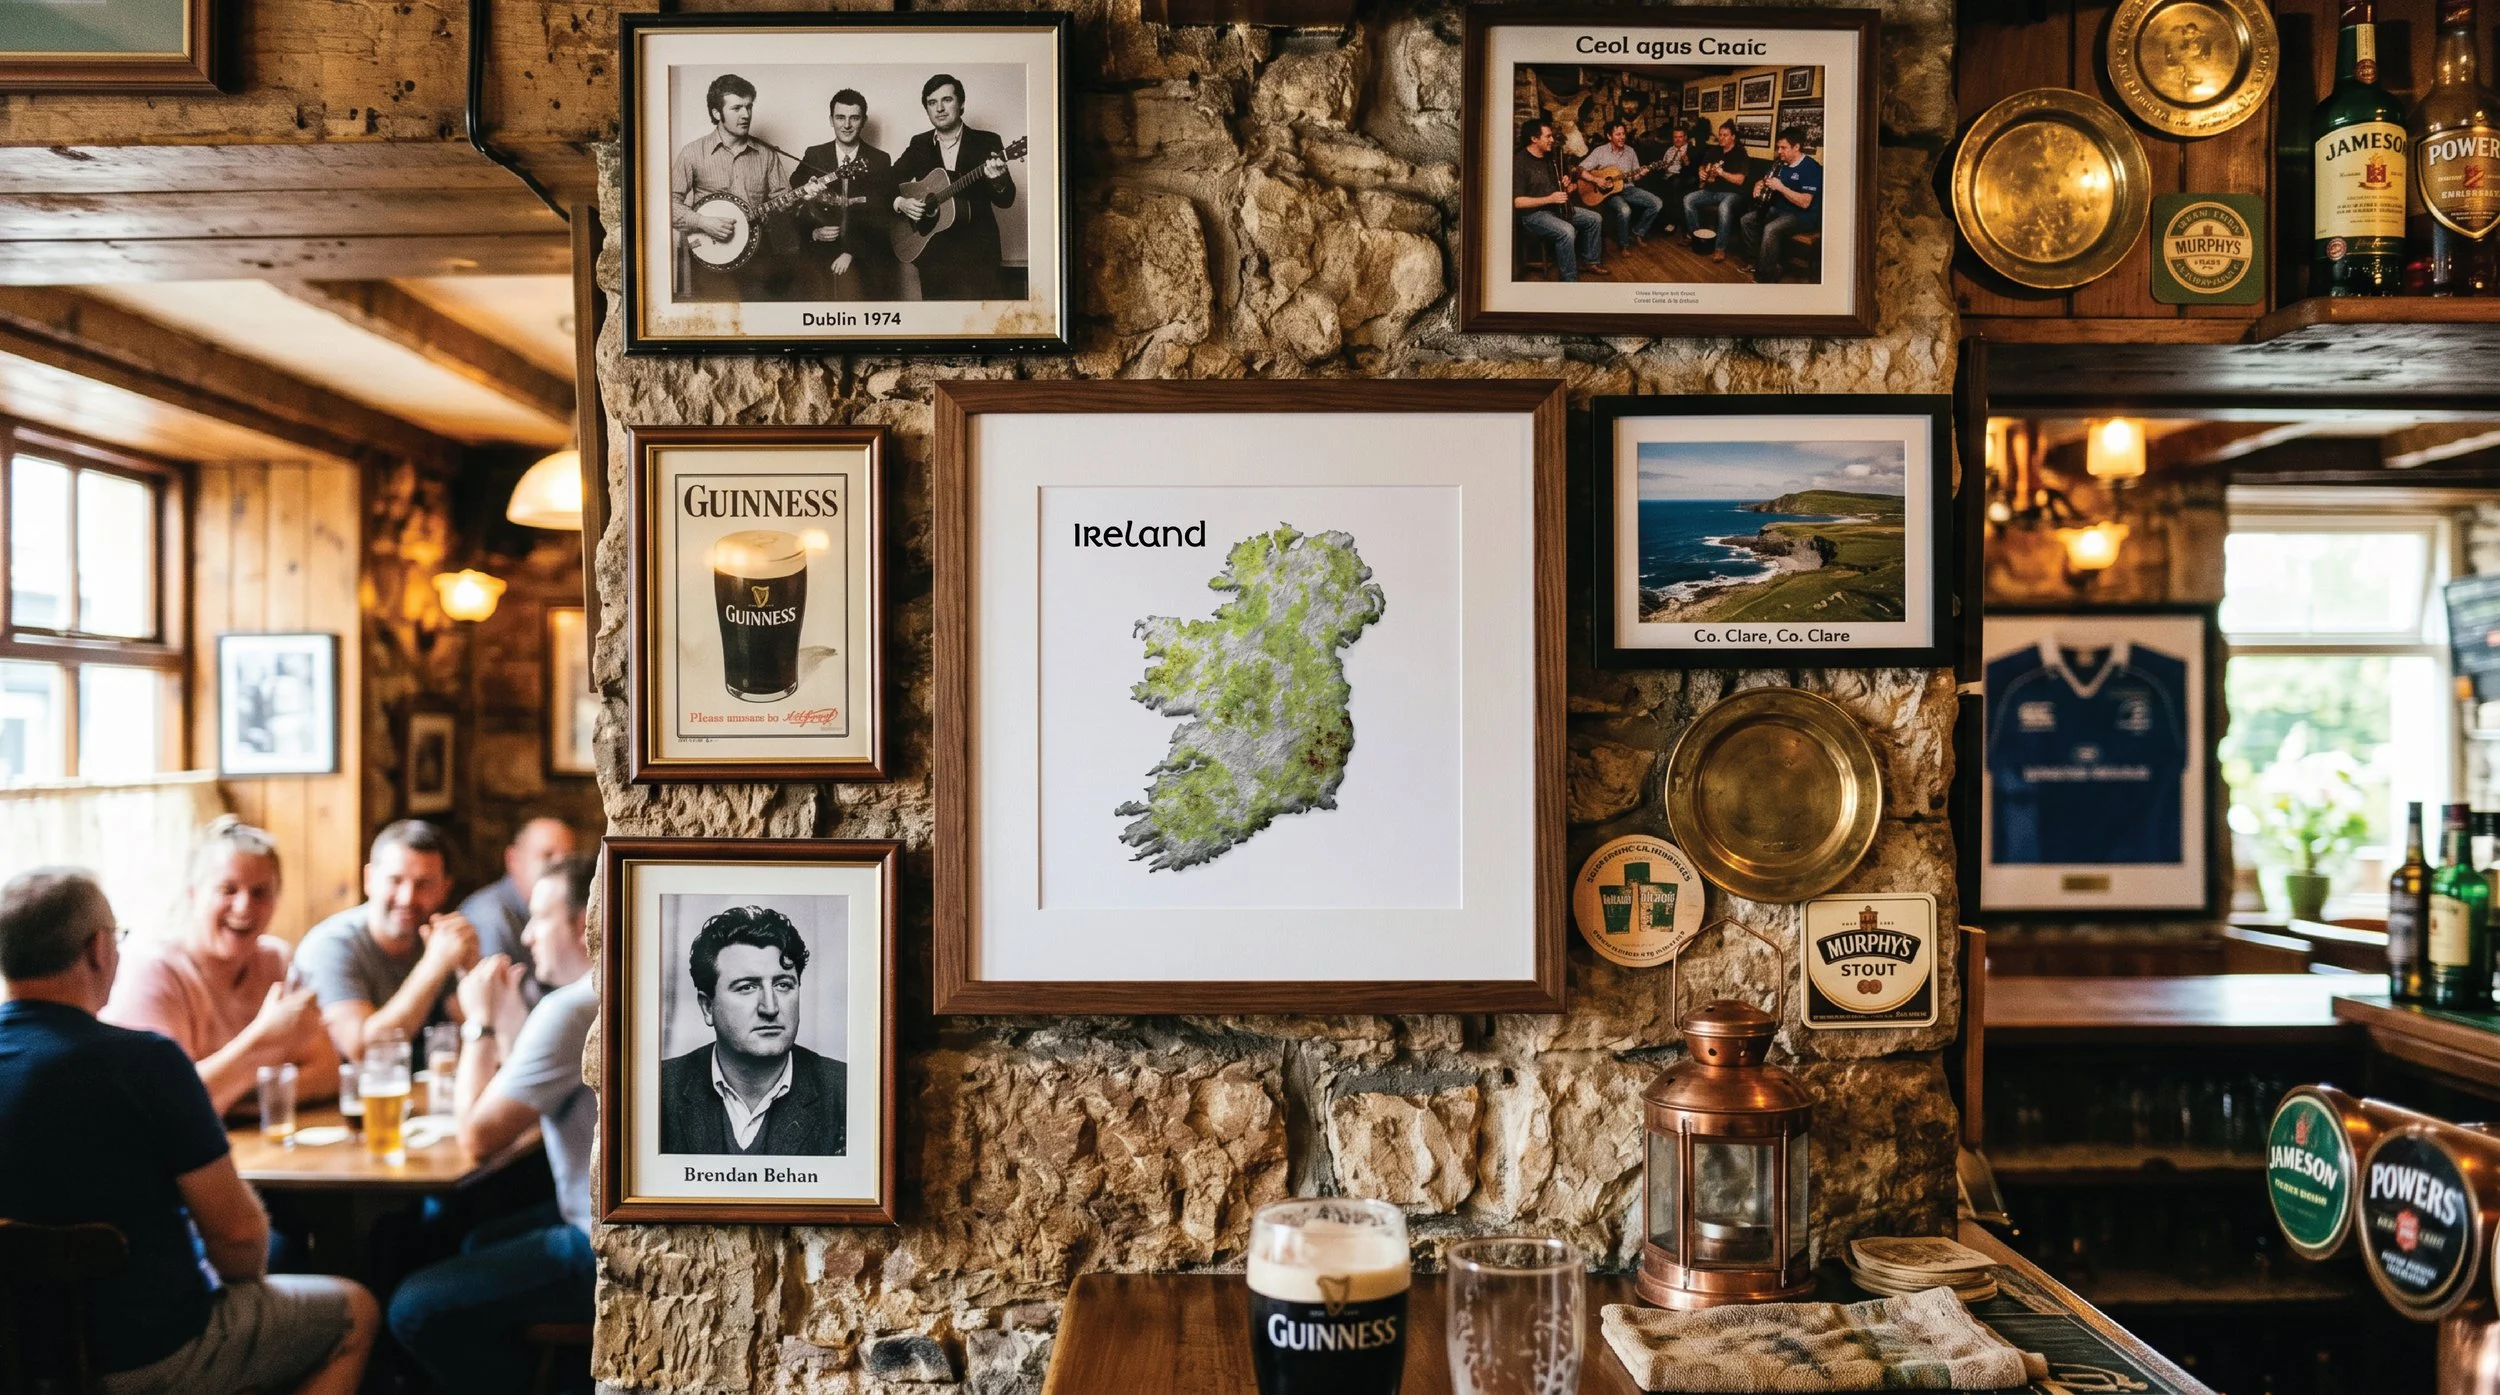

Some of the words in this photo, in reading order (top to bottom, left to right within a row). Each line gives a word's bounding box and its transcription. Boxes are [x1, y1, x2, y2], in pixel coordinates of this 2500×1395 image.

[1575, 35, 1629, 54] Ceol
[1636, 41, 1692, 60] agus
[2175, 238, 2241, 255] MURPHYS
[802, 311, 857, 326] Dublin
[863, 312, 902, 326] 1974
[683, 484, 839, 518] GUINNESS
[1074, 520, 1206, 547] Ireland
[725, 604, 797, 626] GUINNESS
[1693, 628, 1721, 643] Co.
[1725, 628, 1772, 645] Clare,
[1776, 628, 1803, 643] Co.
[1807, 628, 1850, 643] Clare
[1826, 933, 1912, 960] MURPHY'S
[1841, 963, 1897, 977] STOUT
[684, 1166, 758, 1182] Brendan
[764, 1167, 818, 1183] Behan
[2269, 1144, 2339, 1192] JAMESON
[2369, 1161, 2458, 1228] POWERS
[1267, 1313, 1397, 1351] GUINNESS
